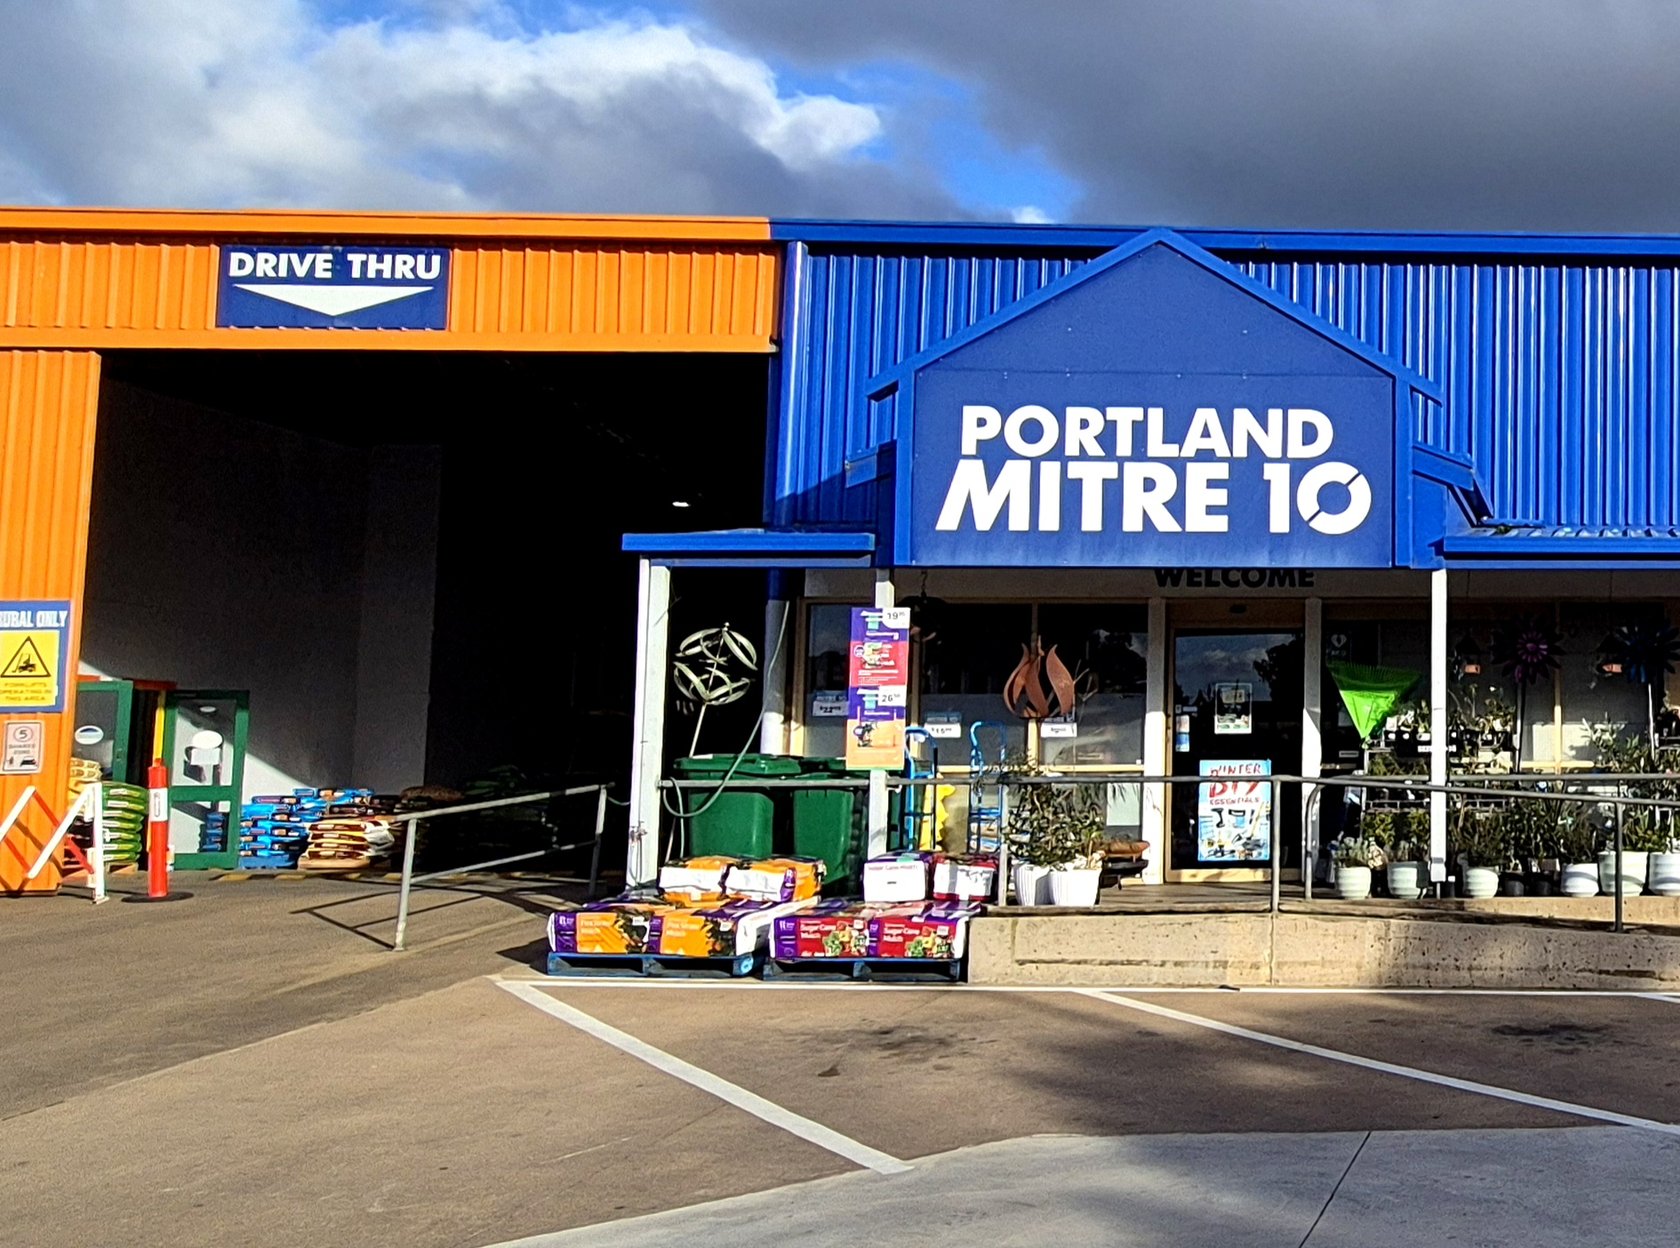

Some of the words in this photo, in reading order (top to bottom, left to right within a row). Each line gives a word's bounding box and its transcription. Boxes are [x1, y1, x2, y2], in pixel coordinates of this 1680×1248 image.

[229, 252, 333, 279] DRIVE
[347, 254, 441, 280] THRU
[961, 404, 1334, 459] PORTLAND
[935, 459, 1230, 533] MITRE
[1263, 461, 1372, 535] 10
[1154, 569, 1315, 588] WELCOME
[0, 610, 34, 628] URAL
[36, 610, 69, 628] ONLY
[19, 729, 28, 739] 5
